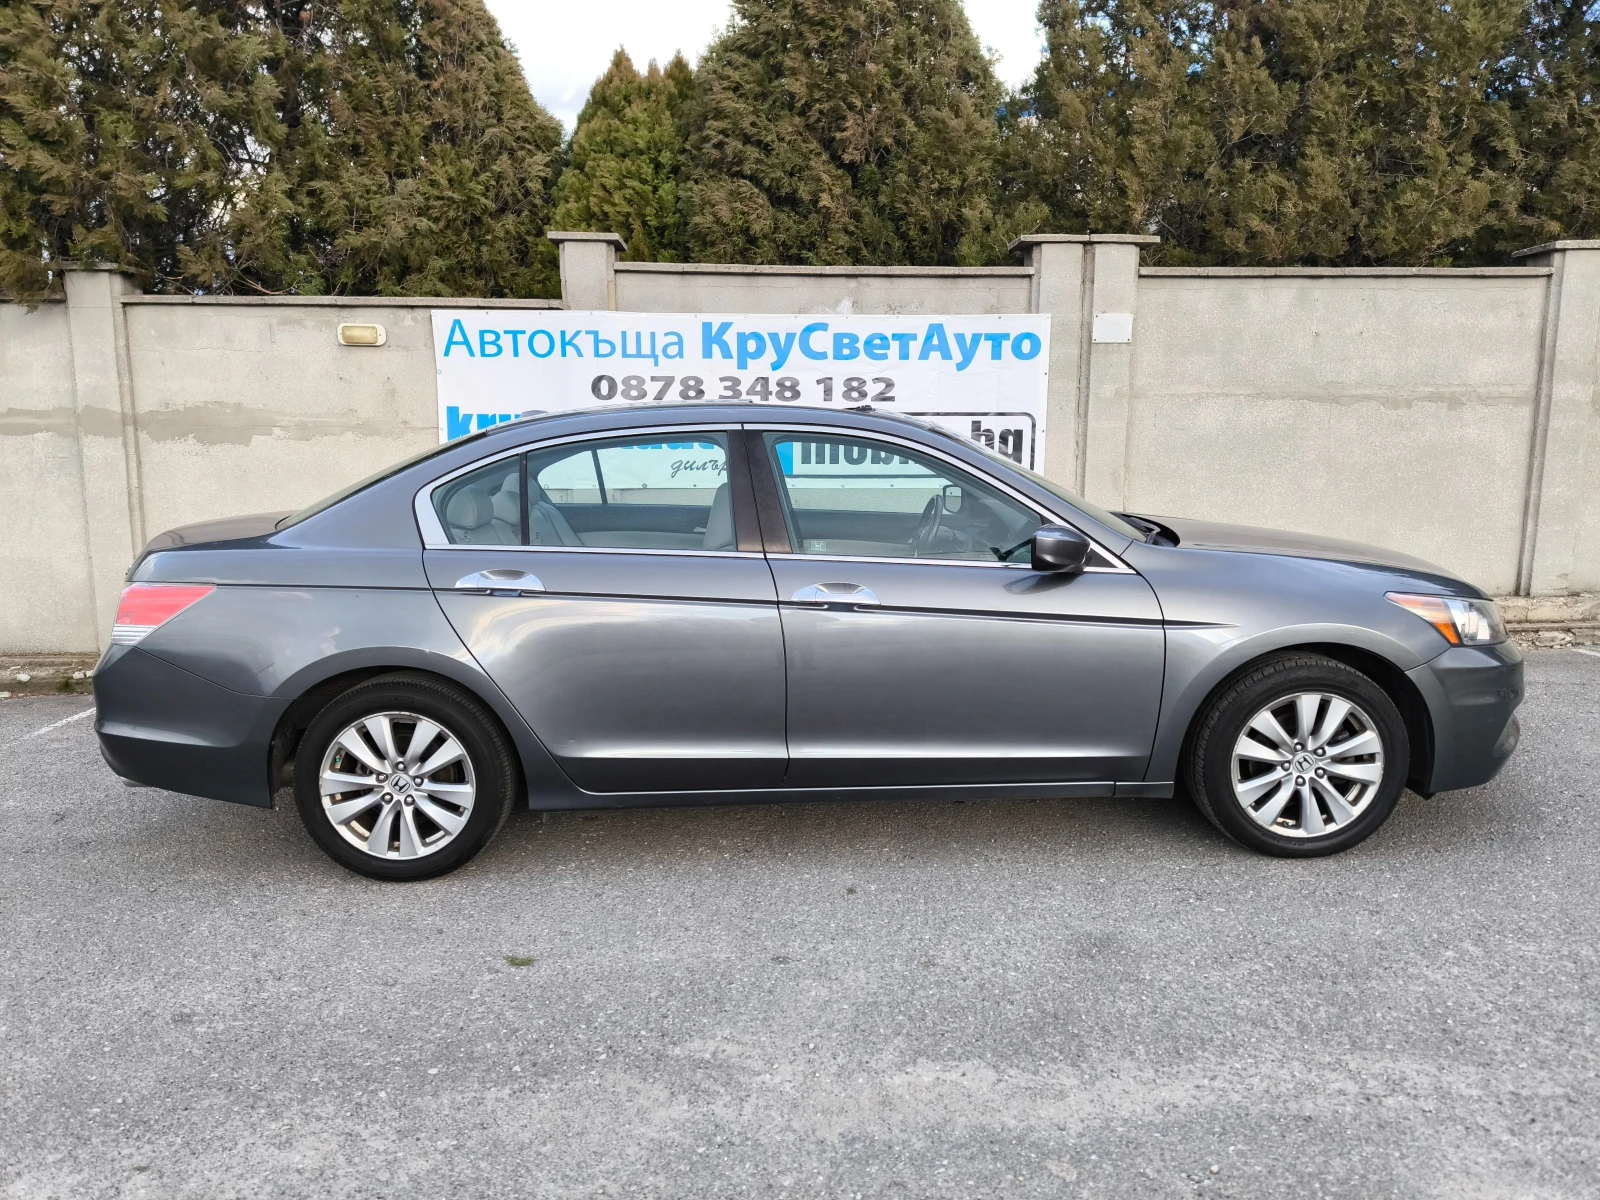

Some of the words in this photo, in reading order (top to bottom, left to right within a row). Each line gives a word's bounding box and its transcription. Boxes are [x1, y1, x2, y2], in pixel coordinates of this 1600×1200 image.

[443, 318, 685, 368] Автокъща
[701, 321, 1043, 372] КруСветАуто
[591, 374, 706, 401] 0878
[718, 375, 802, 402] 348
[815, 376, 896, 403] 182
